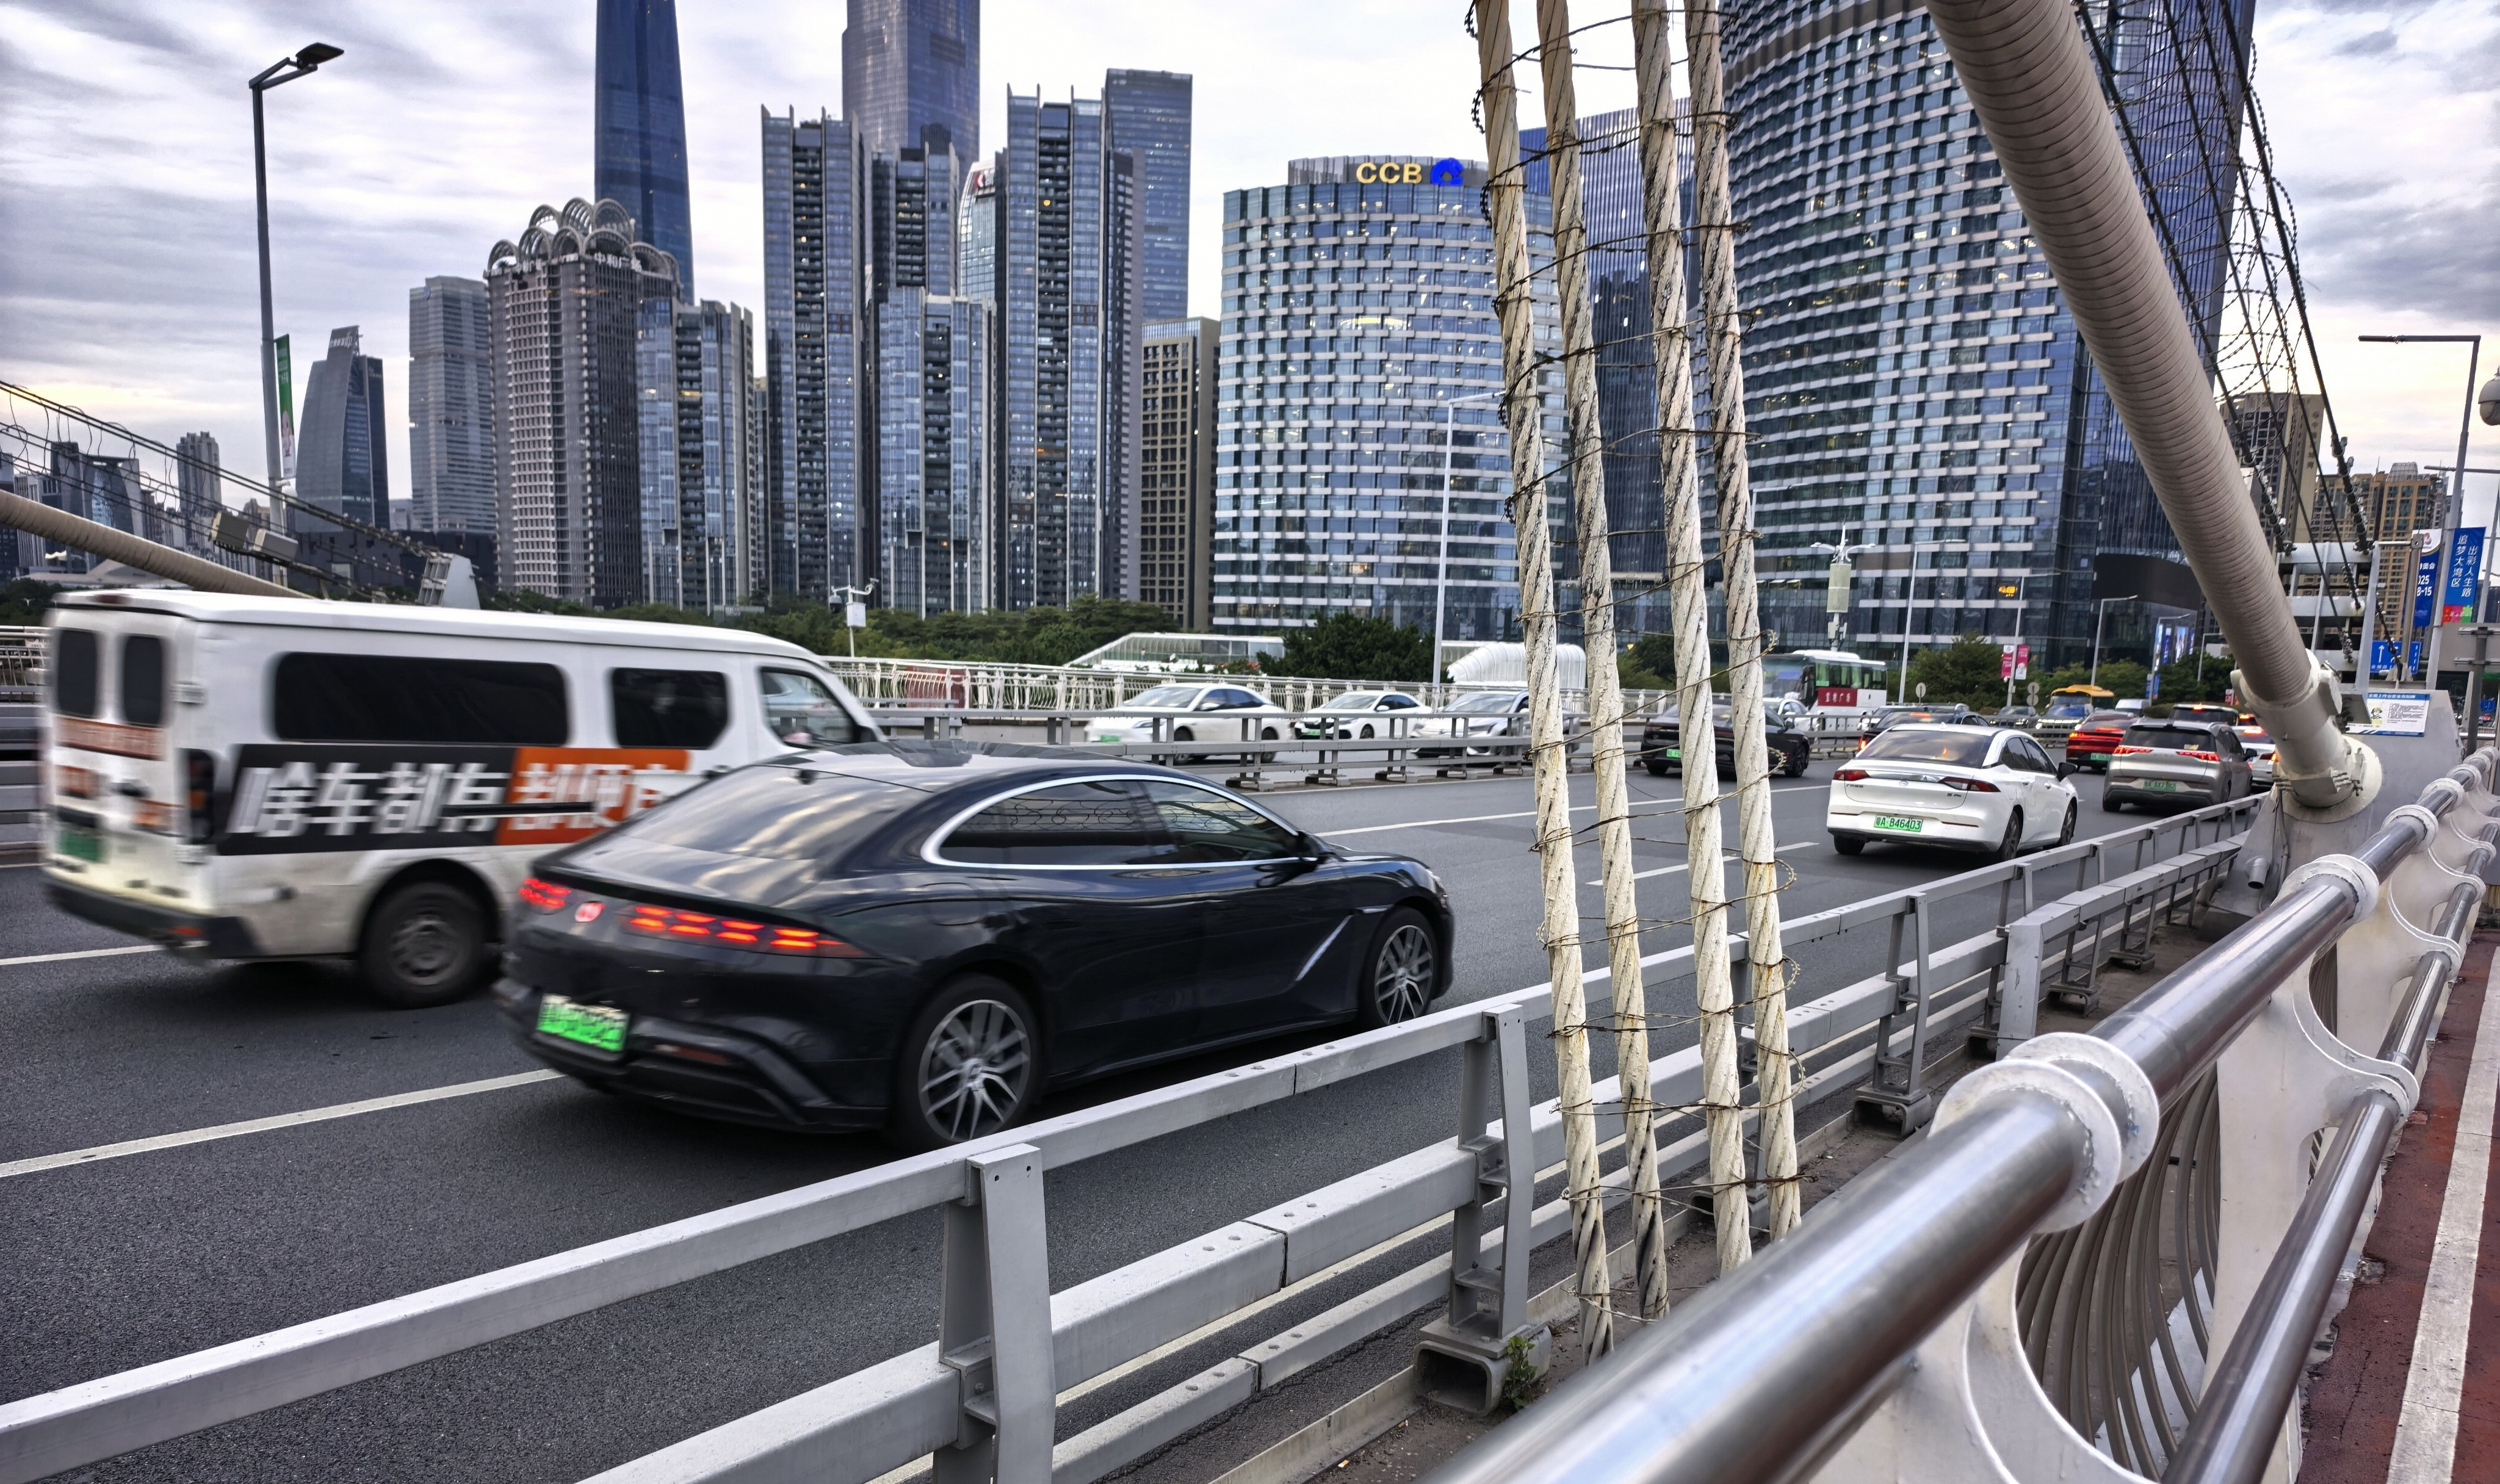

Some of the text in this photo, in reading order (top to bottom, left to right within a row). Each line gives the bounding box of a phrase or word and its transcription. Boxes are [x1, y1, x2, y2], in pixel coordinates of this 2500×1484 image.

[1356, 162, 1422, 184] CCB
[2451, 534, 2468, 587] 追梦大湾区
[2461, 545, 2478, 597] 出彩人生路
